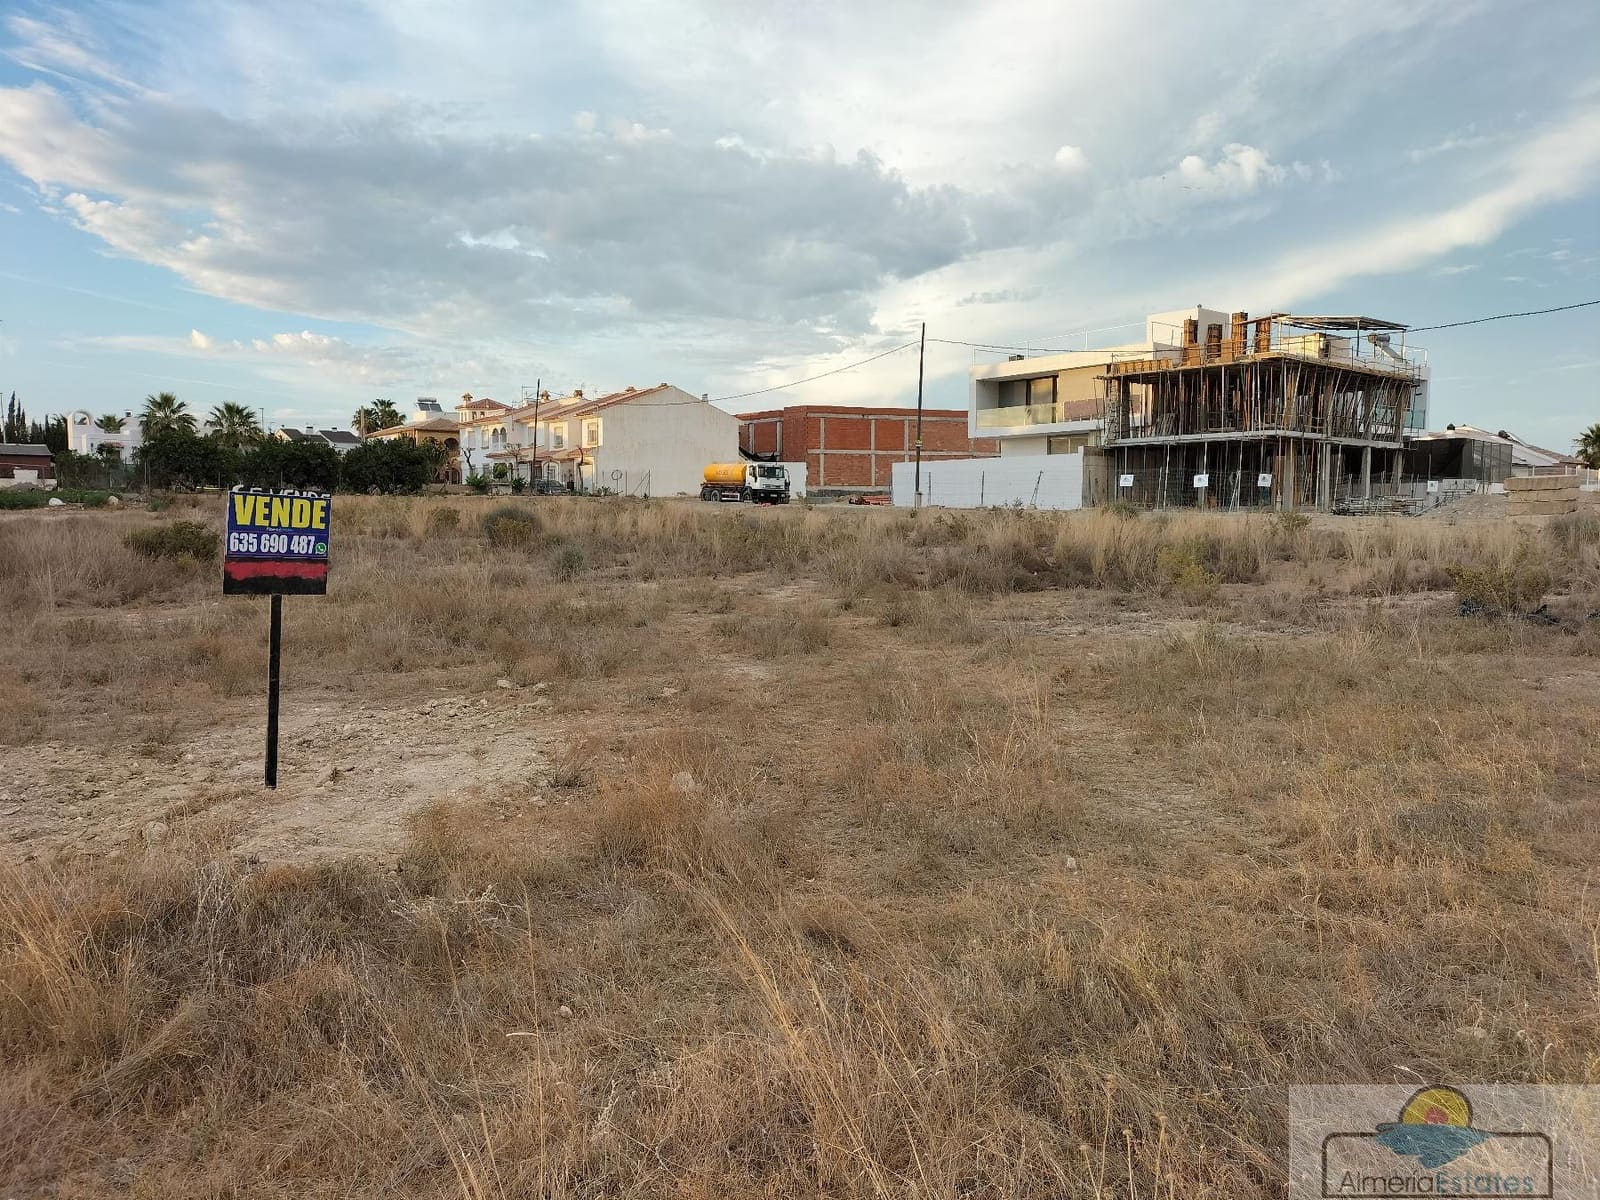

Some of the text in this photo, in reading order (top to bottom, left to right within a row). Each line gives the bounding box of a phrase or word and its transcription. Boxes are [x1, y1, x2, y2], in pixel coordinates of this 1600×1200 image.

[233, 494, 327, 530] VENDE
[229, 532, 316, 554] 635 690 487
